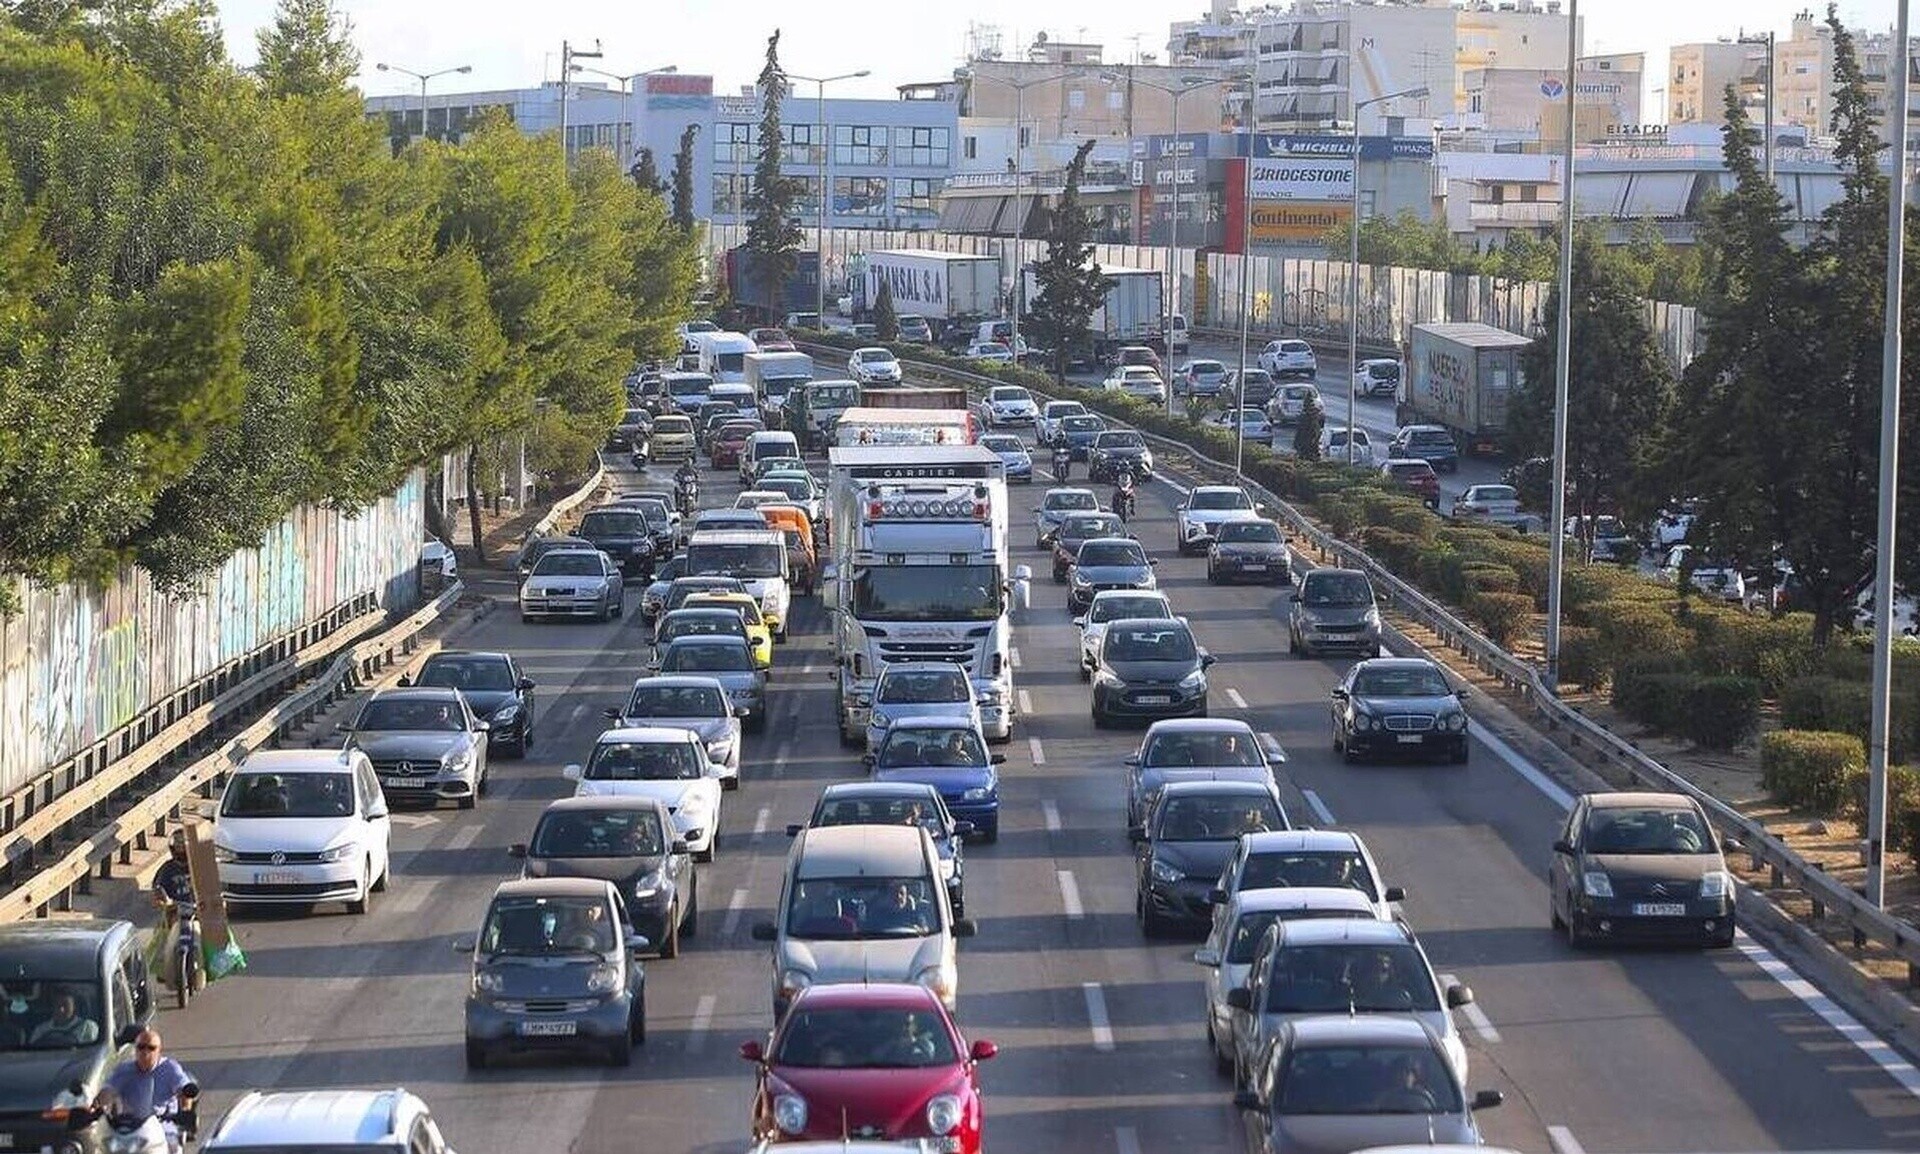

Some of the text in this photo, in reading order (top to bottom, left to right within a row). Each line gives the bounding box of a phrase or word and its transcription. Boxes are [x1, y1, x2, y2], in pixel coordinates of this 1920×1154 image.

[1291, 142, 1362, 153] MICHELIN
[1253, 167, 1352, 182] BRIDGESTONE
[1251, 209, 1338, 227] Continental
[884, 468, 955, 477] CARRIER
